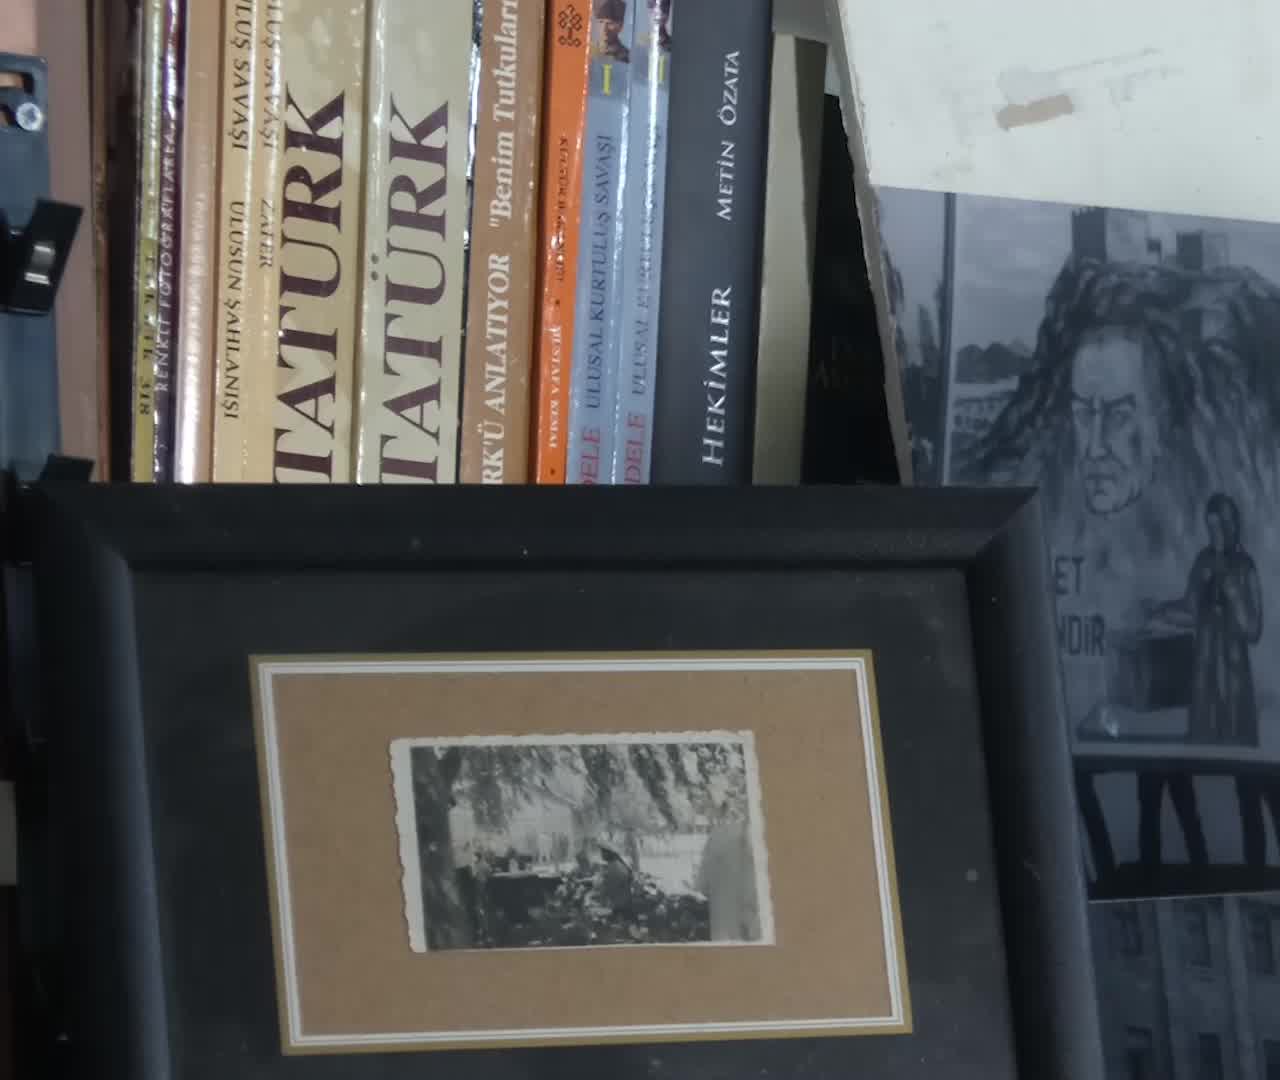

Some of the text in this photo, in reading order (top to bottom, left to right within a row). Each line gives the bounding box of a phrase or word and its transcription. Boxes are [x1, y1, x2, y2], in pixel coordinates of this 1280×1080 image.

[224, 0, 251, 420] LUŞ SAVAŞI ULUSUN ŞAHLANIŞI
[594, 135, 613, 205] SAVAŞI
[589, 212, 611, 321] KURTULUŞ
[702, 50, 740, 467] HEKİMLER METİN ÖZATA
[484, 253, 511, 416] ANLATIYOR
[586, 332, 605, 409] ULUSAL
